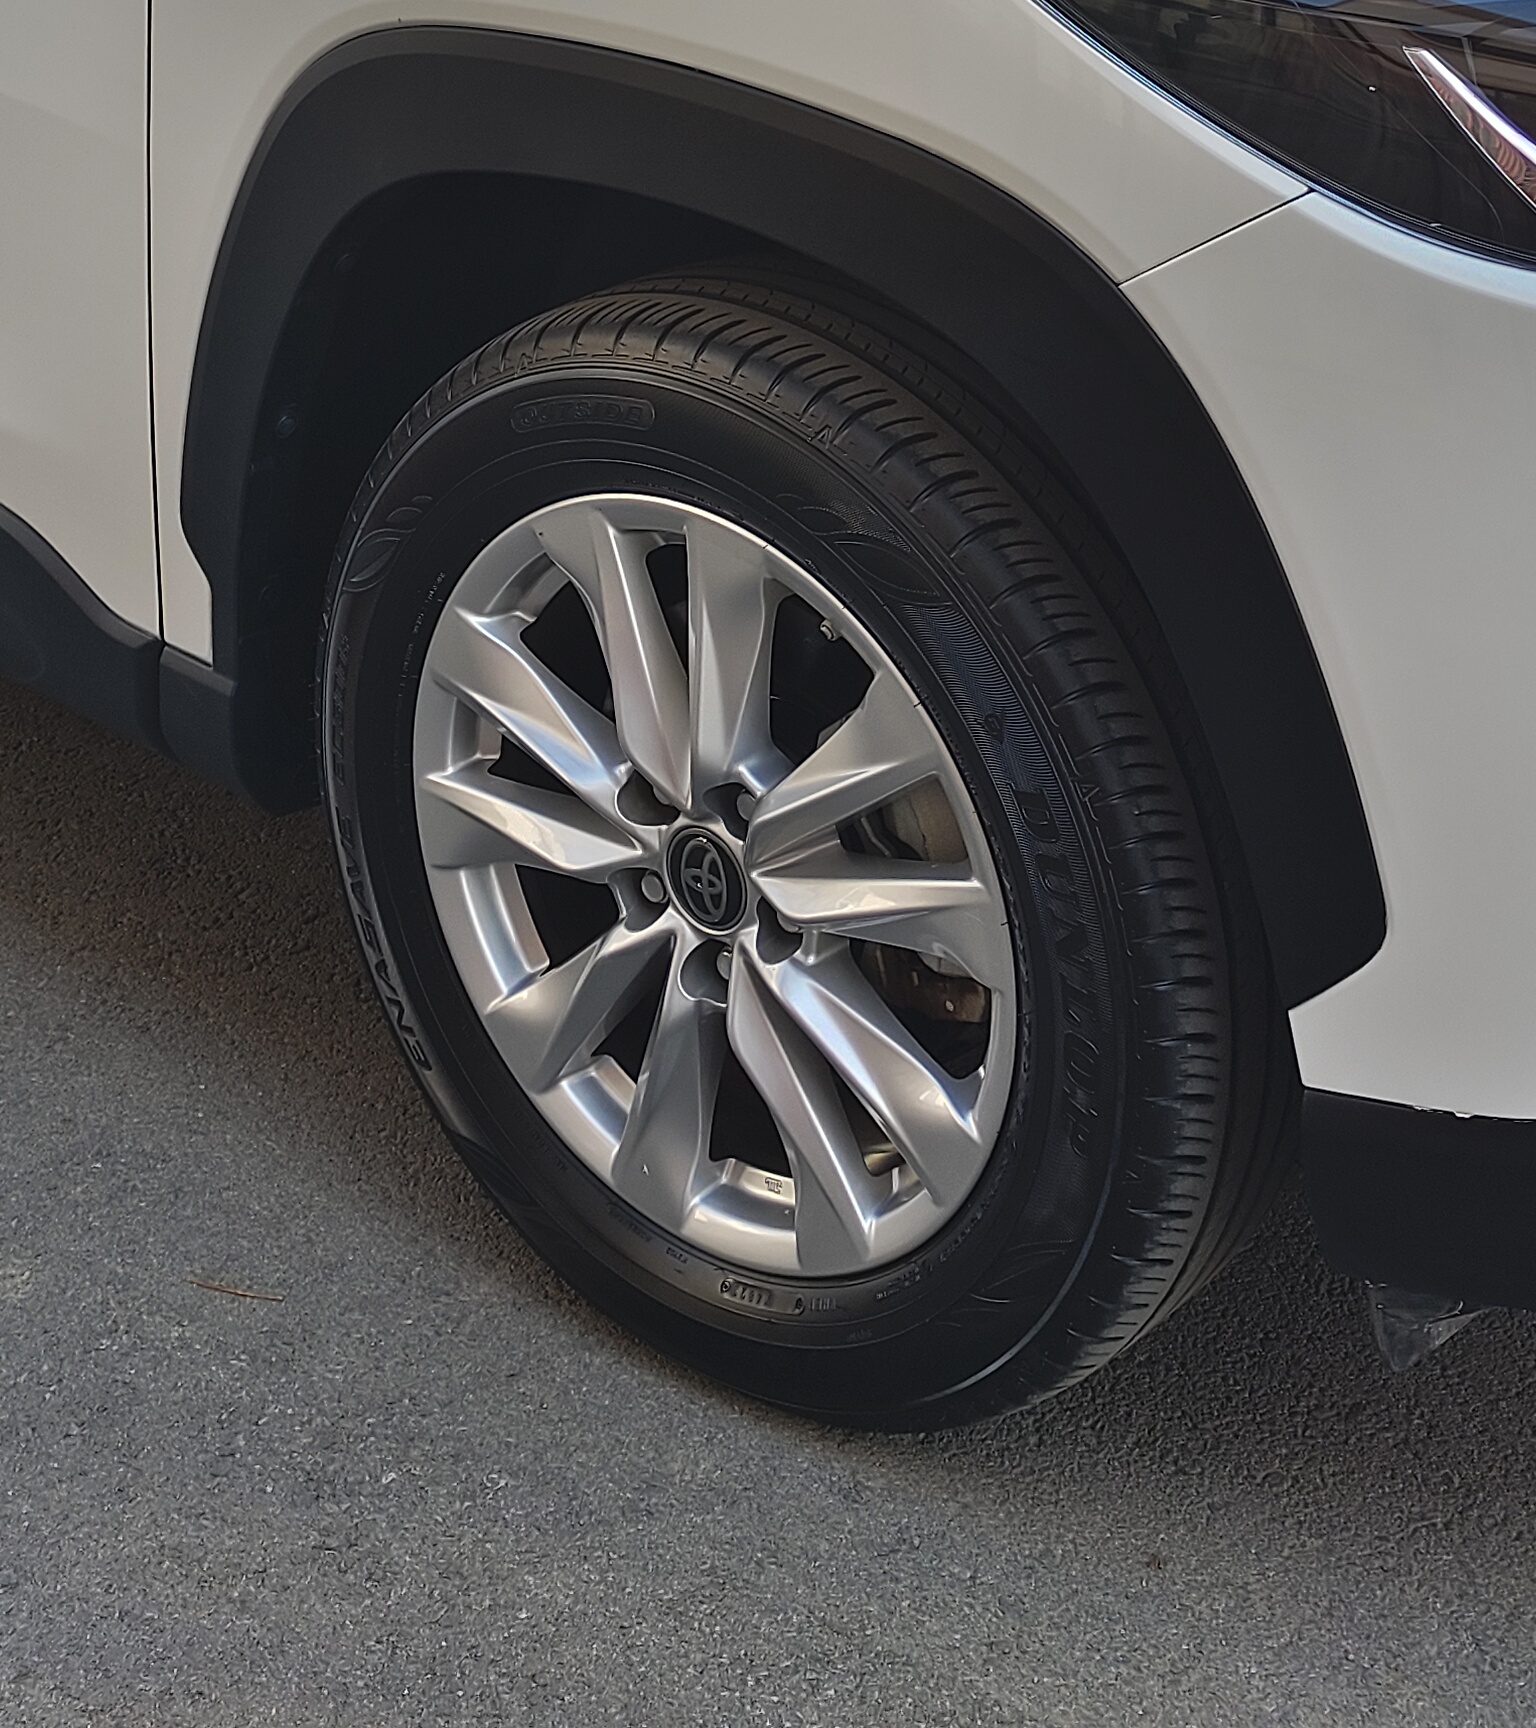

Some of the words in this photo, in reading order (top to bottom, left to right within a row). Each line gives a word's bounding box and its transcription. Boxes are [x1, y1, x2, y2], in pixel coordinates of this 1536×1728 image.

[520, 399, 645, 426] OUTSIDE
[336, 803, 433, 1072] ENASAVE
[1007, 782, 1101, 1158] DUNLOP
